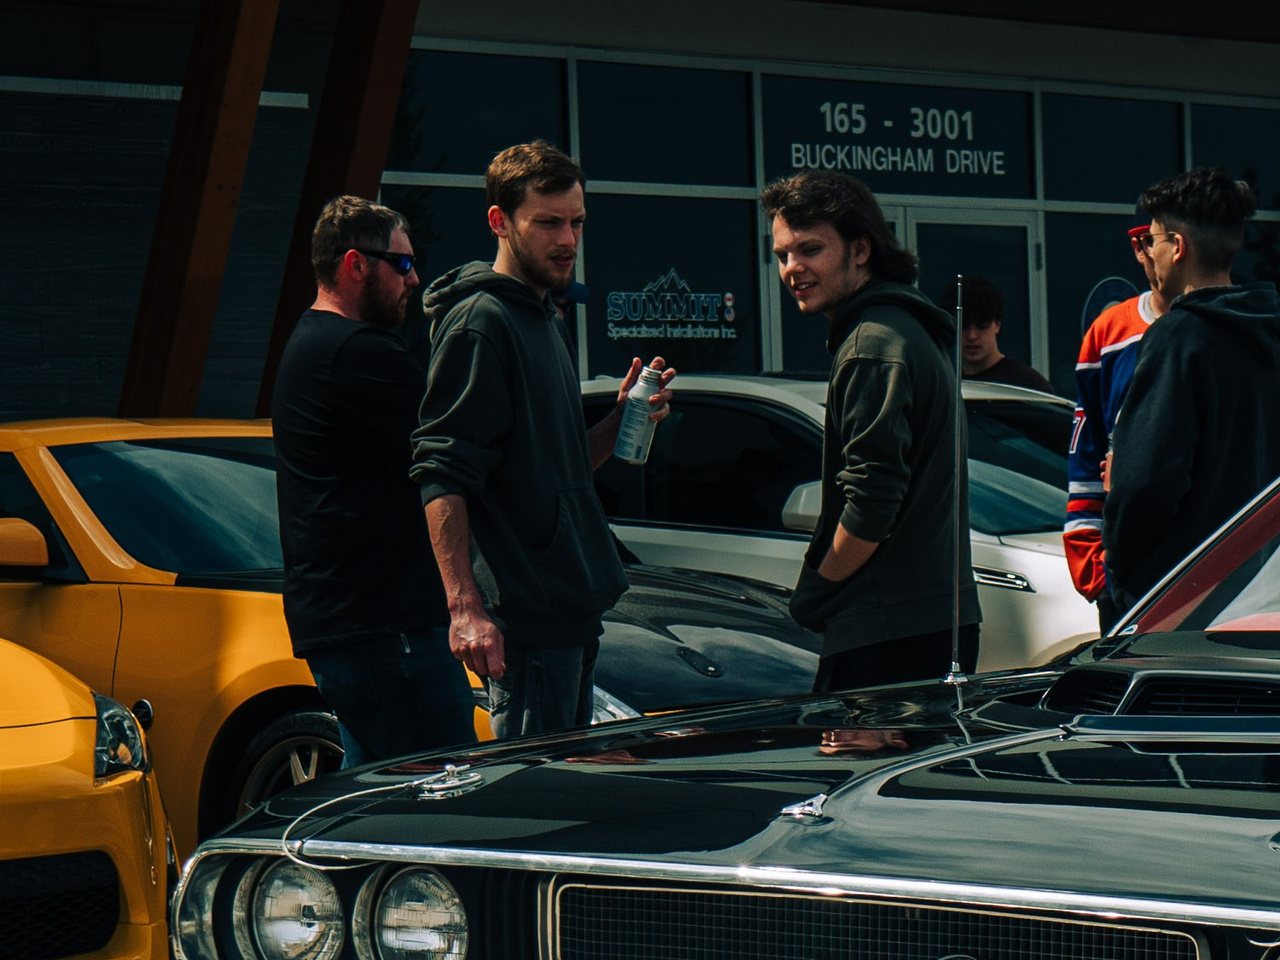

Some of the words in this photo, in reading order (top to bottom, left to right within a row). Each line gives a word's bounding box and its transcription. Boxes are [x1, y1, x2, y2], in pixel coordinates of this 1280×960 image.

[820, 102, 867, 134] 165
[910, 107, 974, 141] 3001
[791, 143, 934, 172] BUCKINGHAM
[946, 149, 1006, 175] DRIVE
[607, 291, 722, 321] SUMMIT
[608, 322, 665, 340] Specialized
